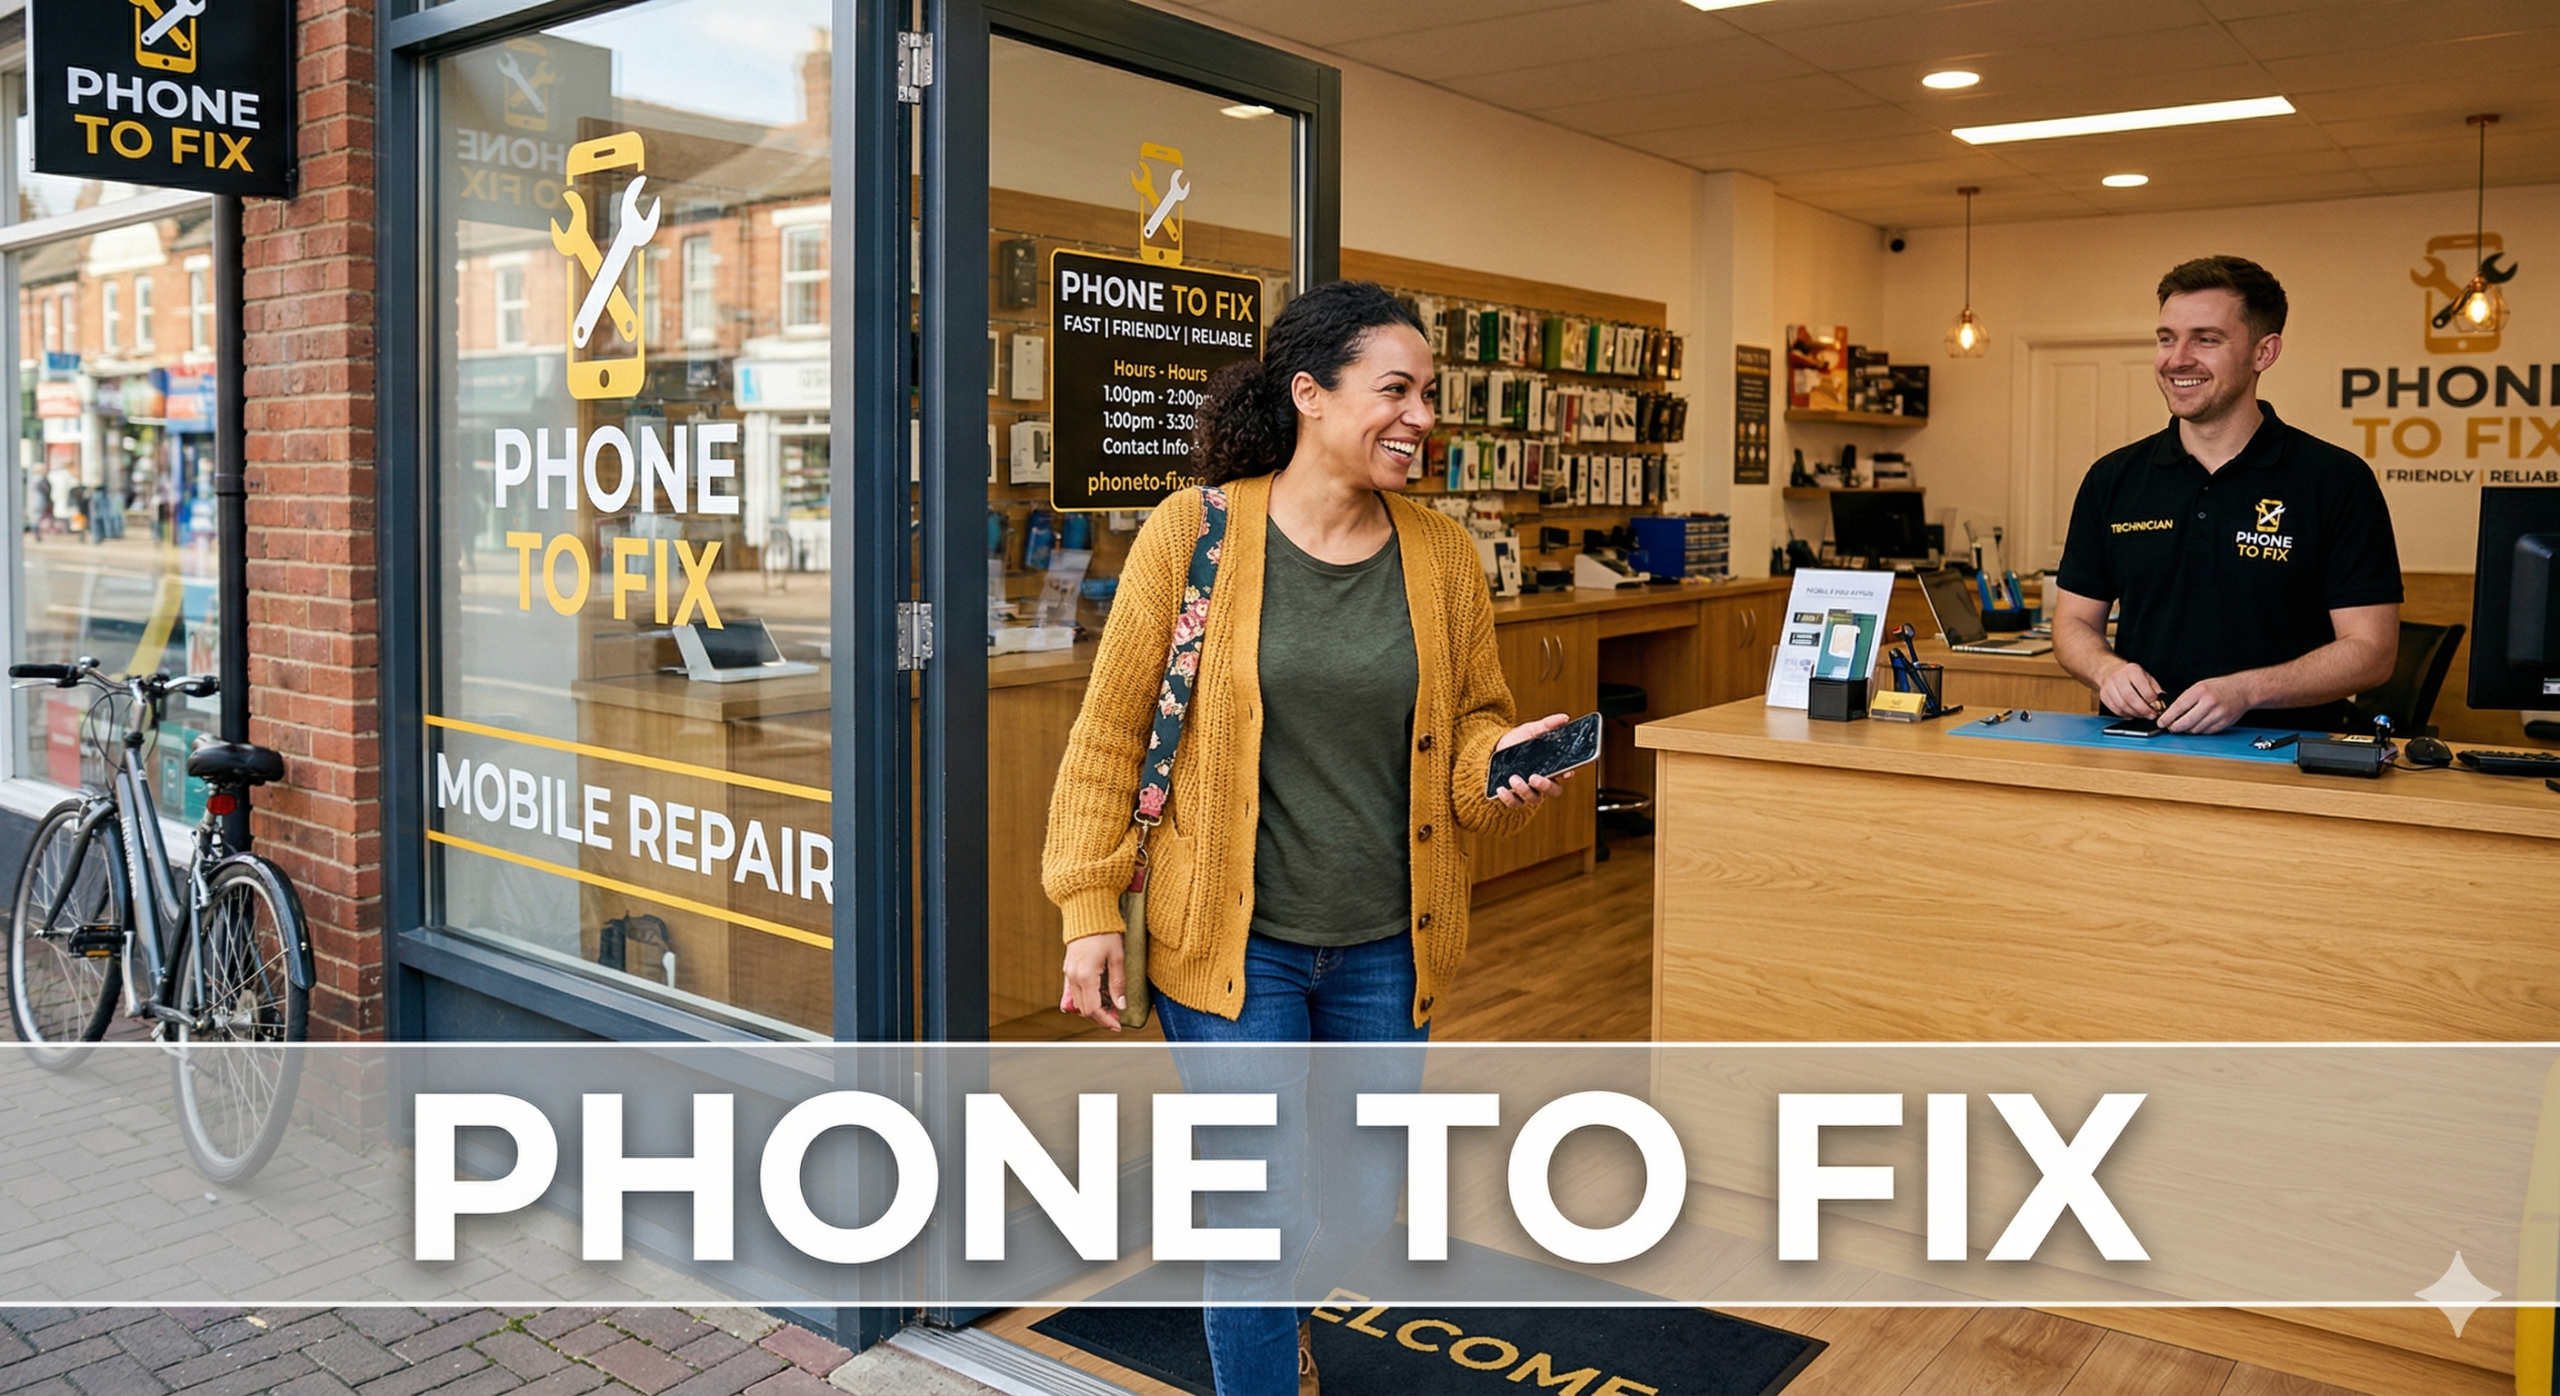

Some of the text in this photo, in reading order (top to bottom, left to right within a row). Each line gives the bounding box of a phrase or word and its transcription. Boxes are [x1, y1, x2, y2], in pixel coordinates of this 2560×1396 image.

[67, 66, 260, 130] PHONE
[74, 113, 254, 173] TO FIX
[1061, 270, 1255, 323] PHONE TO FIX
[1063, 314, 1101, 334] FAST
[1112, 319, 1181, 341] FRIENDLY
[1191, 327, 1254, 349] RELIABLE
[1113, 359, 1157, 379] Hours
[1167, 363, 1208, 382] Hours
[1103, 384, 1155, 407] 1.00pm
[1166, 388, 1213, 410] 2:00p
[1103, 411, 1155, 433] 1:00pm
[1166, 413, 1199, 431] 3:30
[2352, 416, 2560, 460] TO FIX
[1102, 437, 1160, 455] Contact
[494, 422, 740, 515] PHONE
[2386, 469, 2475, 483] FRIENDLY
[2235, 531, 2293, 549] PHONE
[2237, 544, 2290, 562] TO FIX
[506, 531, 724, 629] TO FIX
[437, 752, 834, 905] MOBILE REPAIR
